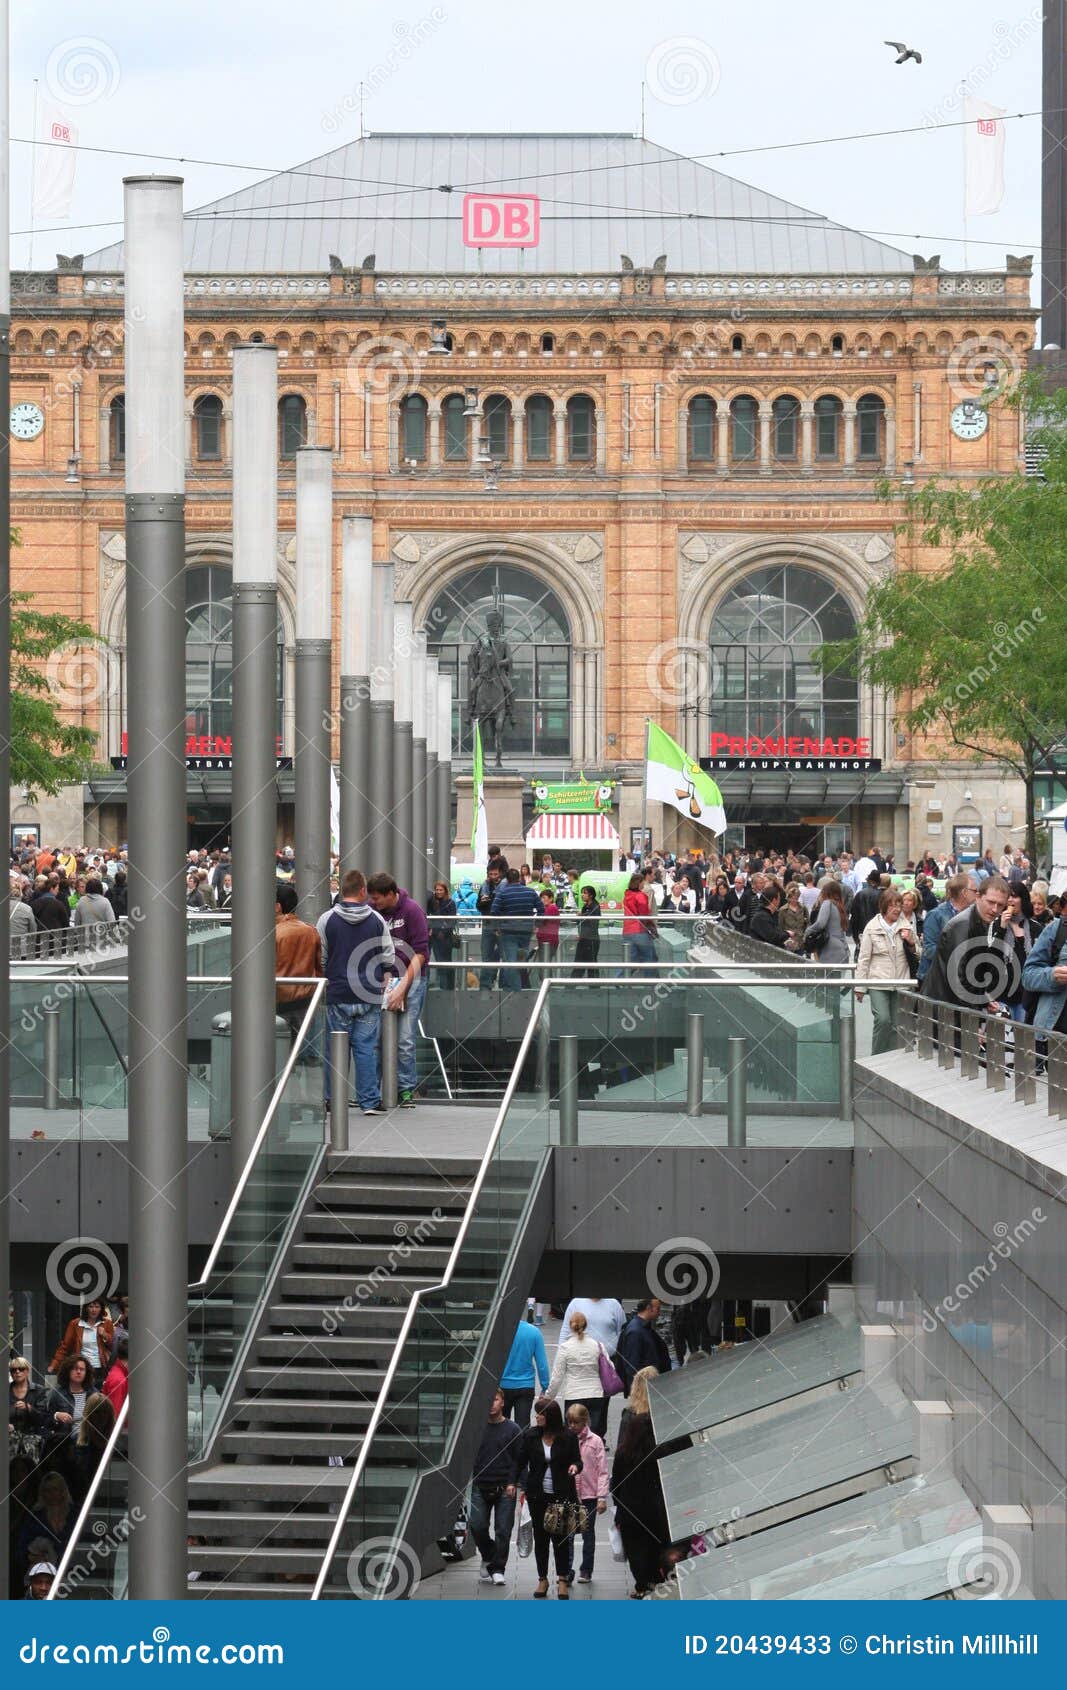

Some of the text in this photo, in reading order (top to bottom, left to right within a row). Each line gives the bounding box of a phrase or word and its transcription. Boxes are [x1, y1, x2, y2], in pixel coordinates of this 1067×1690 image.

[472, 202, 531, 239] DB
[710, 732, 870, 758] PROMENADE
[709, 761, 870, 769] IM HAUPTBAHNHOF
